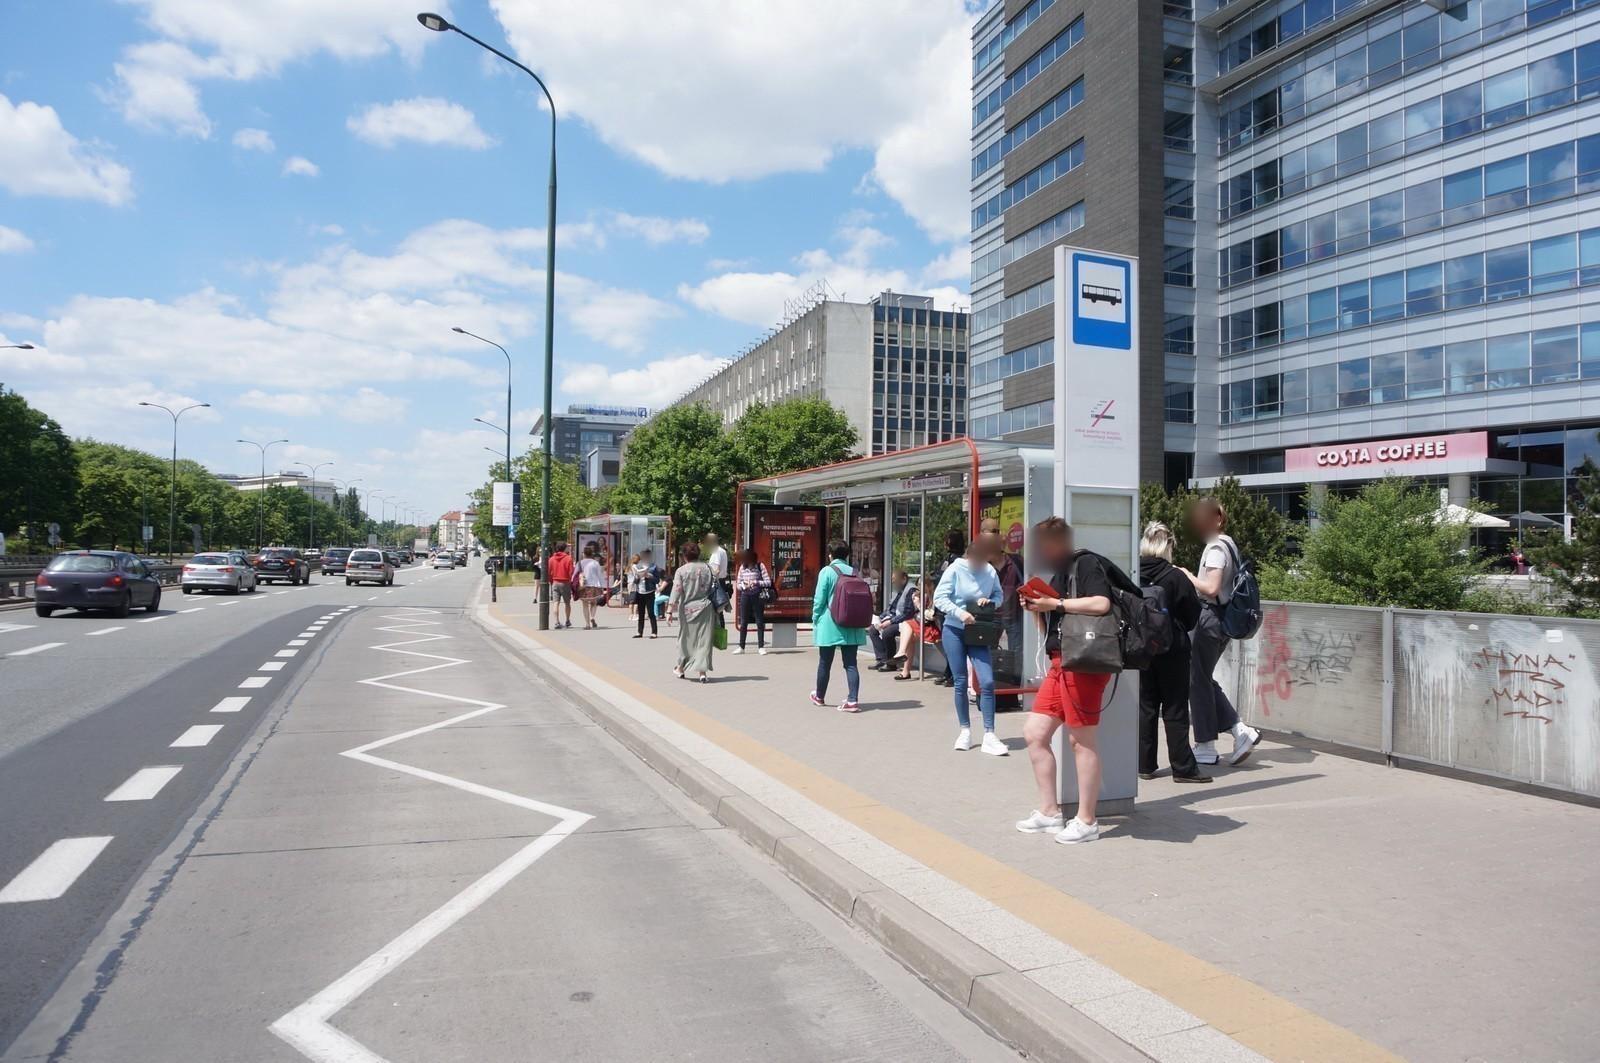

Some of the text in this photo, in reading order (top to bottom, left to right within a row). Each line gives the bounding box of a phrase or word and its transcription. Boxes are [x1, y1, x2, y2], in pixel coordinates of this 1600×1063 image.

[1317, 440, 1448, 467] COSTA COFFEE
[778, 541, 801, 549] MARCIN
[778, 551, 801, 559] MELLER
